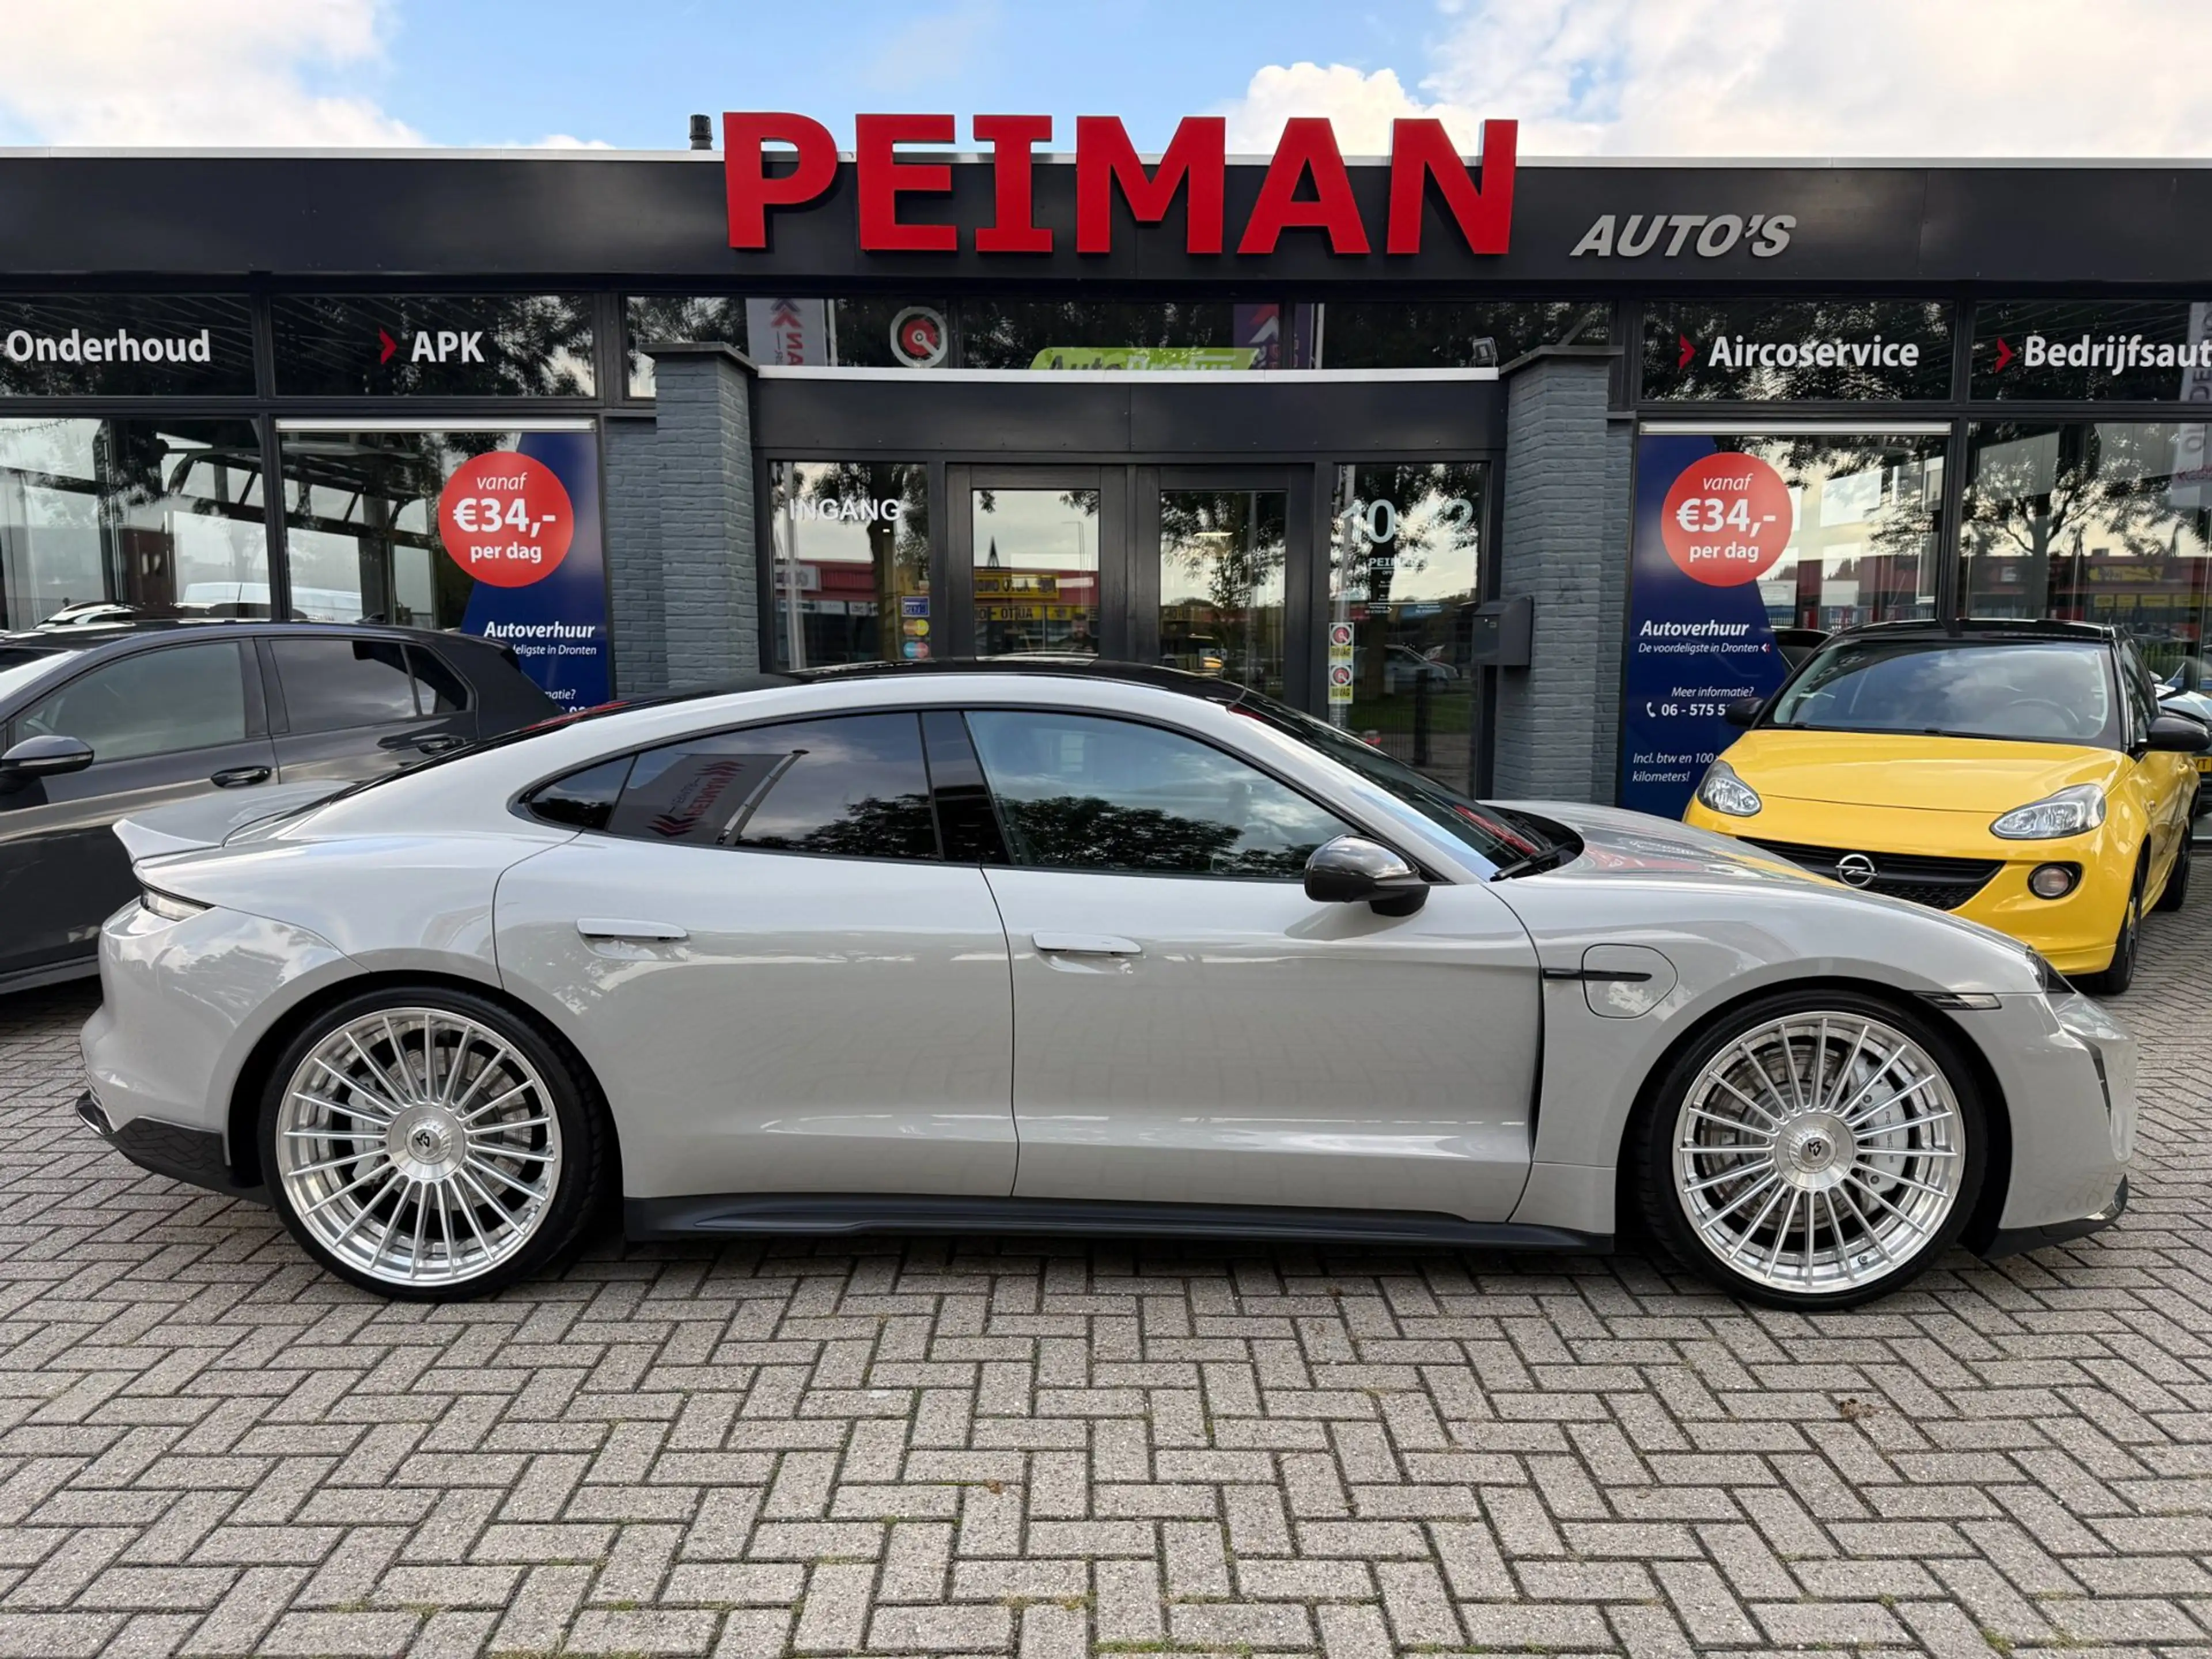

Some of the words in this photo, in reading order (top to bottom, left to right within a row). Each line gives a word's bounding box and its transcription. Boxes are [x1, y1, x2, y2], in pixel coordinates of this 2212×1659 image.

[723, 111, 1519, 255] PEIMAN
[1569, 214, 1797, 257] AUTO'S
[6, 328, 211, 363] Onderhoud
[411, 331, 485, 363] APK
[1708, 335, 1919, 368] Aircoservice
[2024, 334, 2212, 376] Bedrijfsaut
[477, 472, 528, 490] vanaf
[1703, 473, 1754, 491] vanaf
[453, 497, 556, 538] €34,-
[789, 498, 900, 521] INGANG
[1676, 497, 1777, 538] €34,-
[470, 546, 502, 563] per
[506, 542, 542, 563] dag
[1689, 546, 1721, 563] per
[1724, 541, 1759, 563] dag
[484, 621, 596, 638] Autoverhuur
[1639, 619, 1750, 637] Autoverhuur
[547, 644, 556, 655] in
[558, 645, 597, 656] Dronten
[1638, 642, 1652, 653] De
[1653, 642, 1710, 656] voordeligste
[1710, 642, 1719, 653] in
[1721, 642, 1759, 653] Dronten
[1671, 687, 1697, 698] Meer
[1698, 685, 1755, 698] informatie?
[1661, 703, 1679, 717] 06
[1688, 703, 1715, 717] 575
[1717, 703, 1731, 717] 5
[1633, 752, 1654, 764] Incl.
[1656, 752, 1677, 764] btw
[1679, 755, 1692, 764] en
[1695, 752, 1714, 764] 100
[1632, 770, 1691, 782] kilometers!
